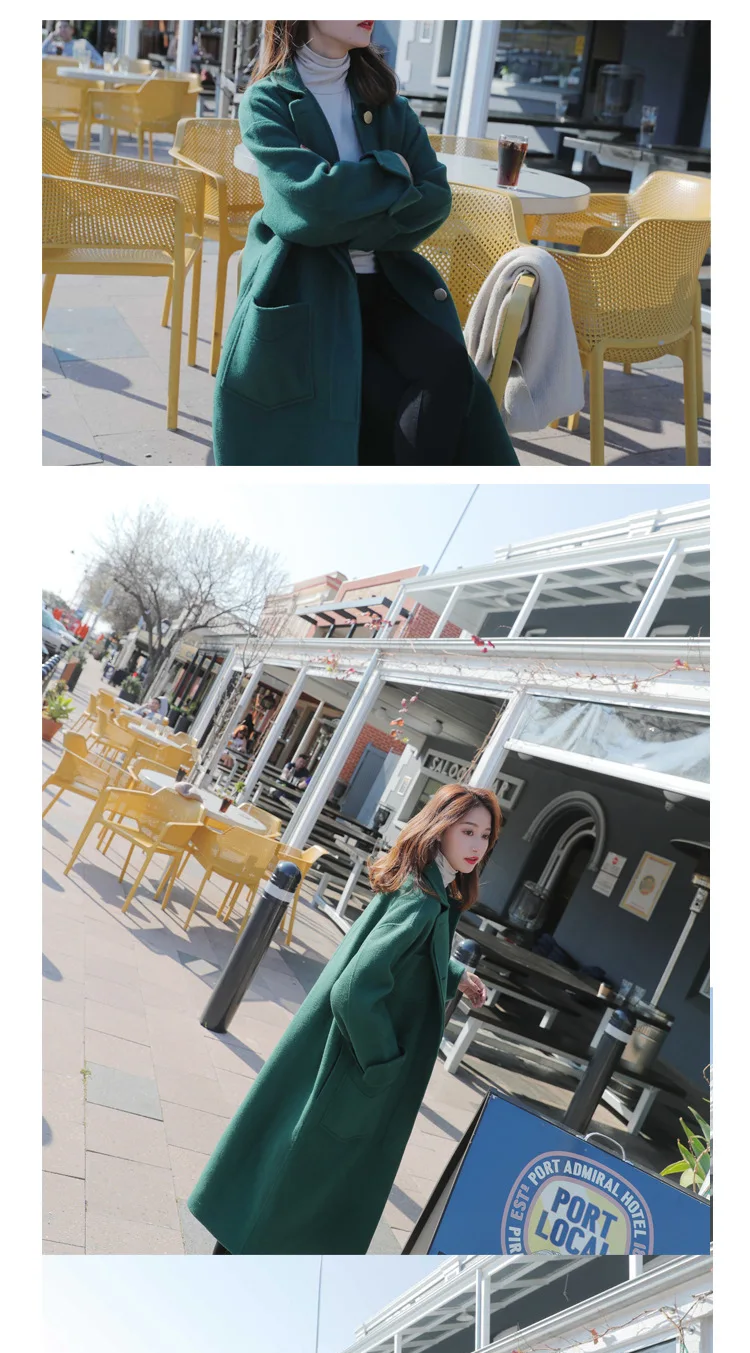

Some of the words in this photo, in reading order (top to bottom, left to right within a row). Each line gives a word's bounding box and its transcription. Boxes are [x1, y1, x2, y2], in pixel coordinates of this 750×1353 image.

[527, 1159, 561, 1186] PORT
[563, 1160, 620, 1198] ADMIRAL
[620, 1190, 647, 1239] HOTEL
[551, 1187, 618, 1240] PORT
